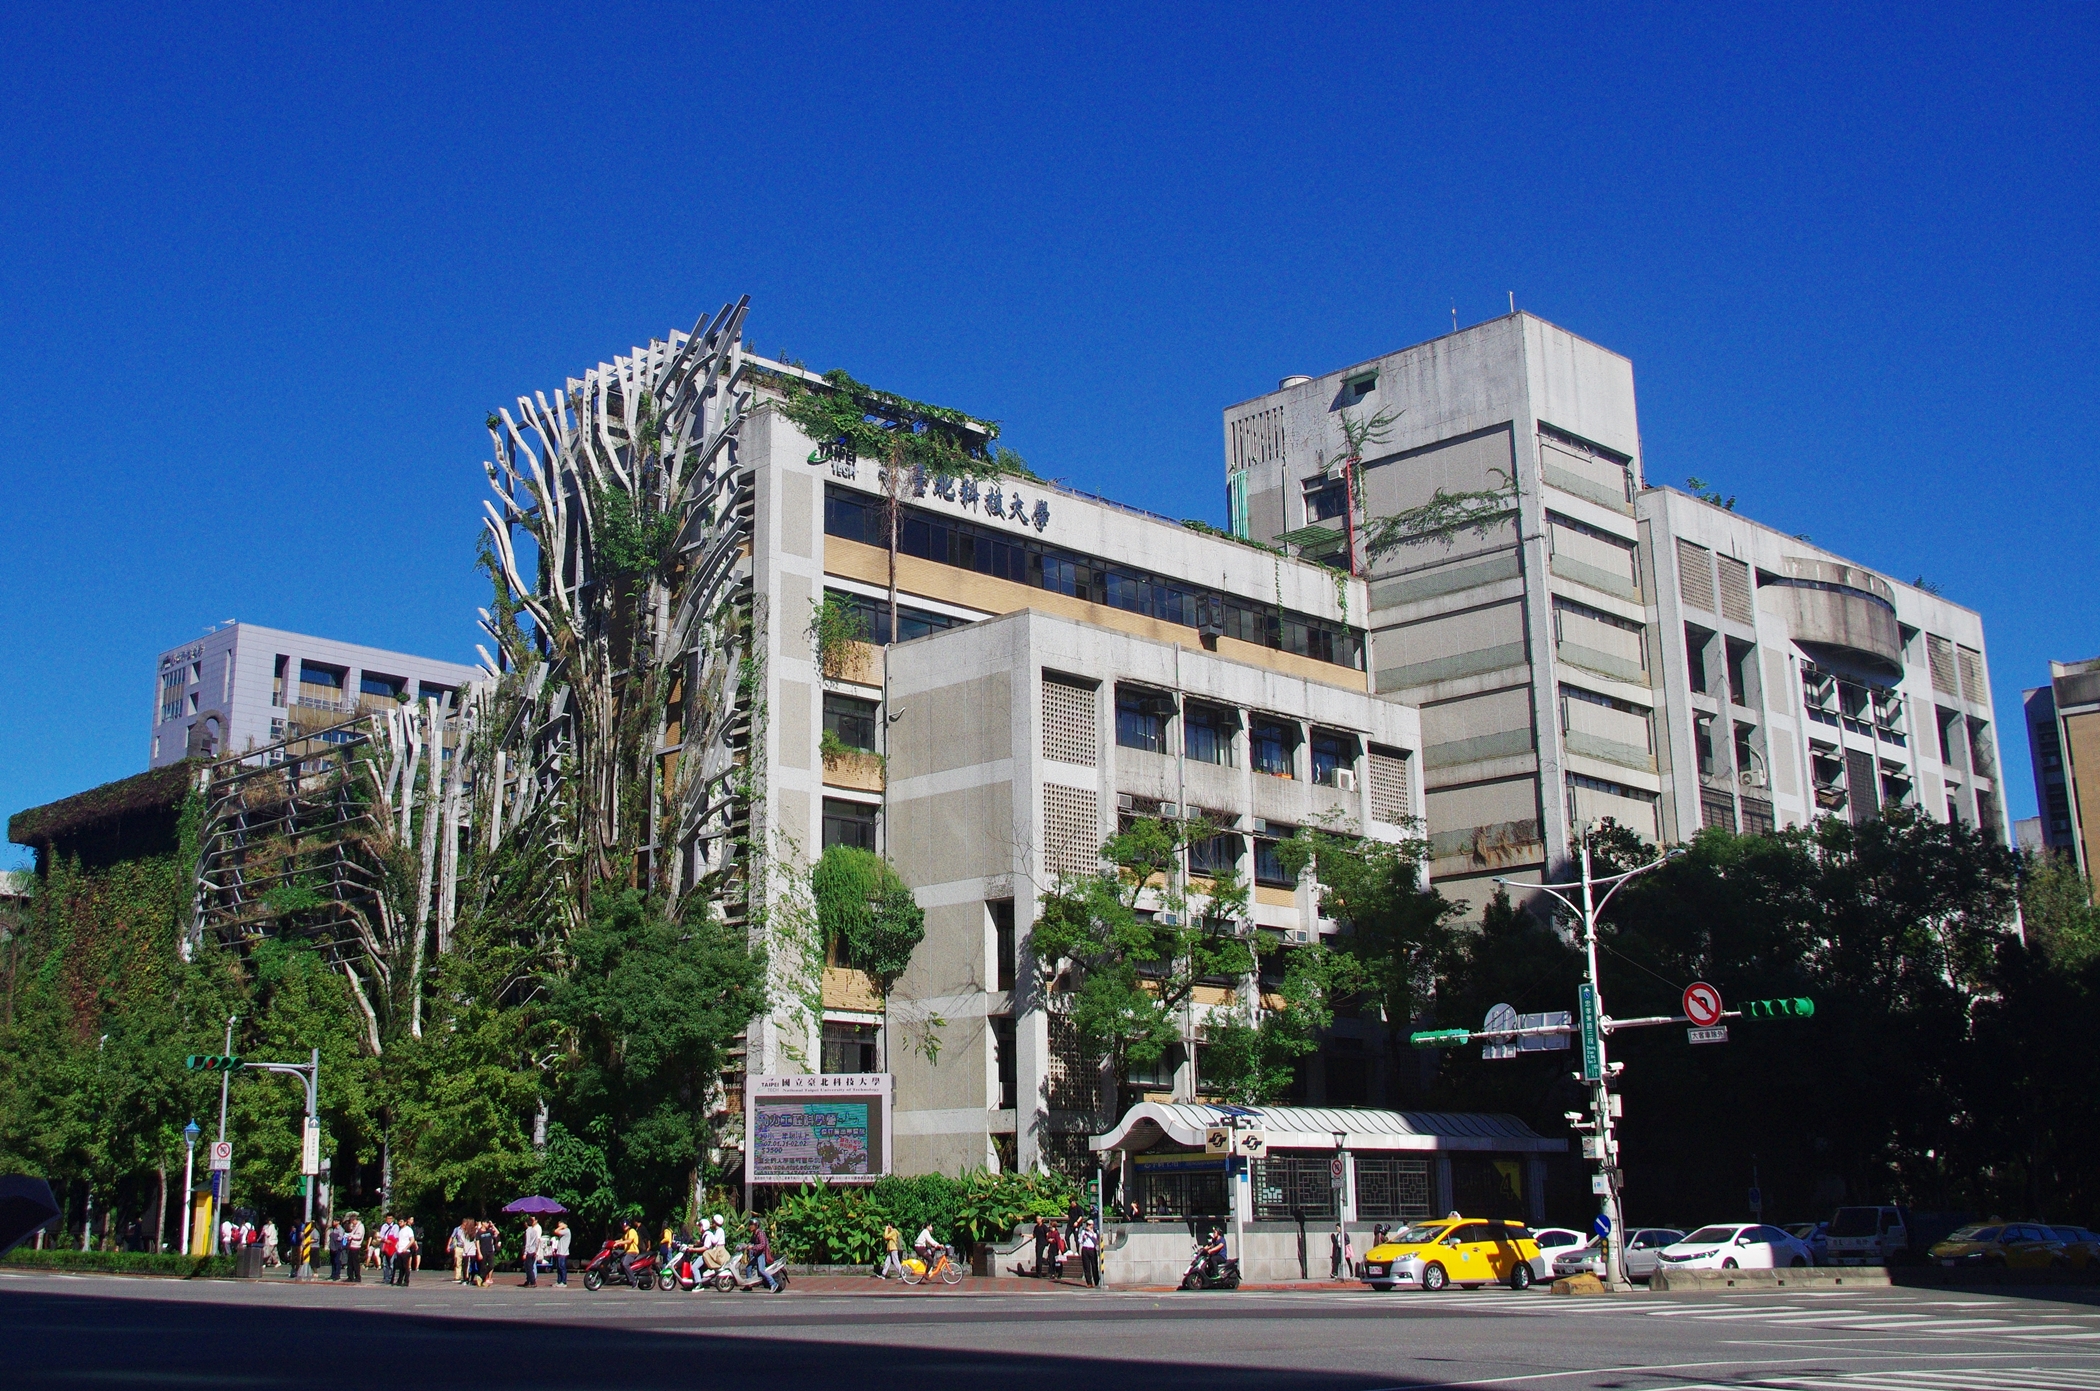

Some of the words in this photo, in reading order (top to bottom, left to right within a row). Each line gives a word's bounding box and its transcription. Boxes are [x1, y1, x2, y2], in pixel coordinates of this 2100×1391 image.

[818, 441, 857, 466] TAIPEI
[831, 460, 857, 481] TECH
[781, 1077, 880, 1087] 國立臺北科技大學
